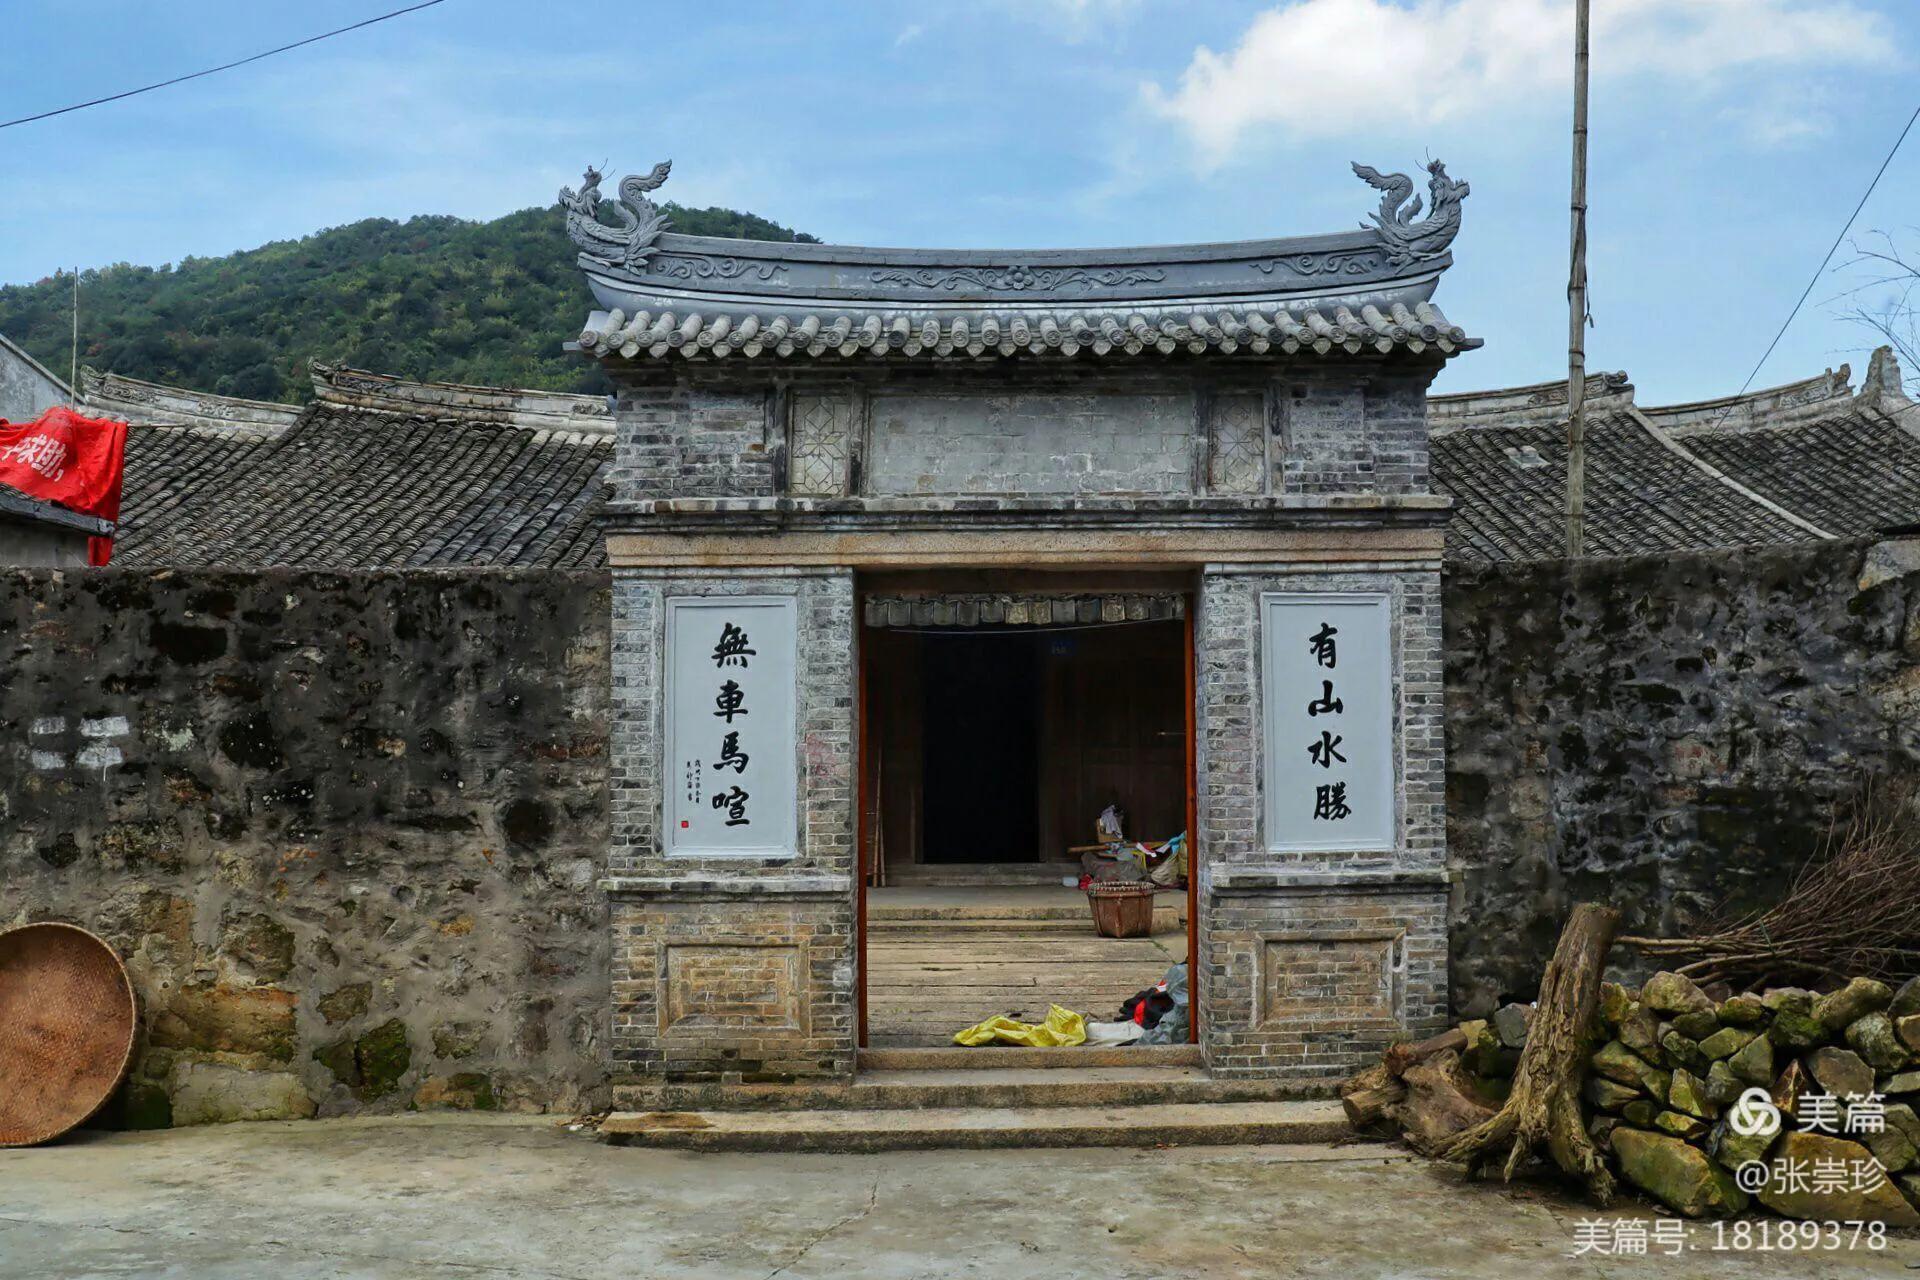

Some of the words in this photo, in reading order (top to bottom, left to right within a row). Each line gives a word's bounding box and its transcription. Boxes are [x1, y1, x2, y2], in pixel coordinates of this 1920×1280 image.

[711, 622, 757, 827] 無車馬喧
[1306, 622, 1352, 822] 有山水勝
